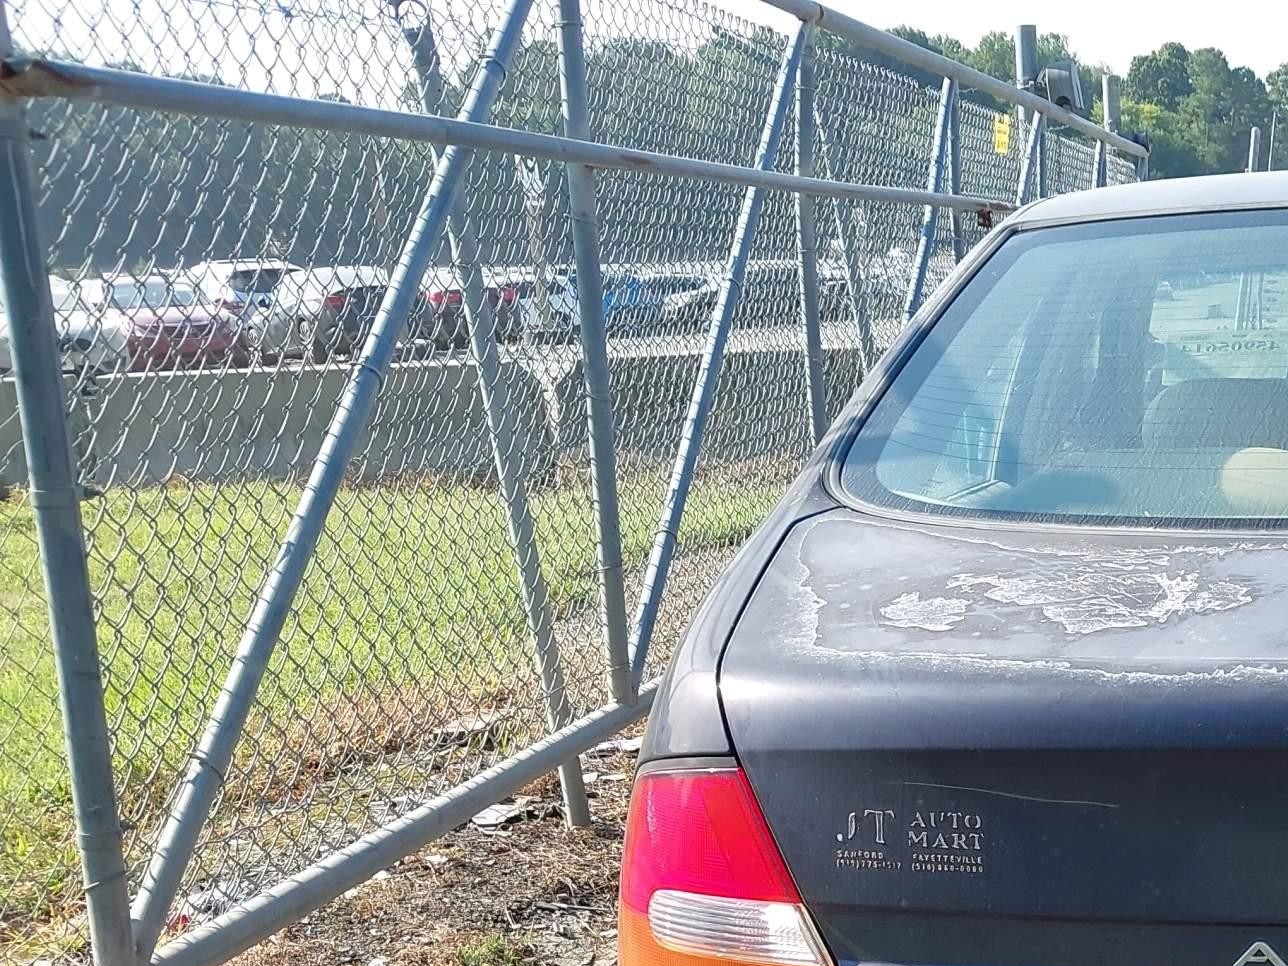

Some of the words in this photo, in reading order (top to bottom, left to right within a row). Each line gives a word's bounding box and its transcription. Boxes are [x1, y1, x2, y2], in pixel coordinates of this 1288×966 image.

[910, 811, 982, 829] AUTO
[908, 830, 985, 850] MART
[836, 849, 884, 860] SANFORD
[912, 853, 983, 865] FAYETTEVILLE
